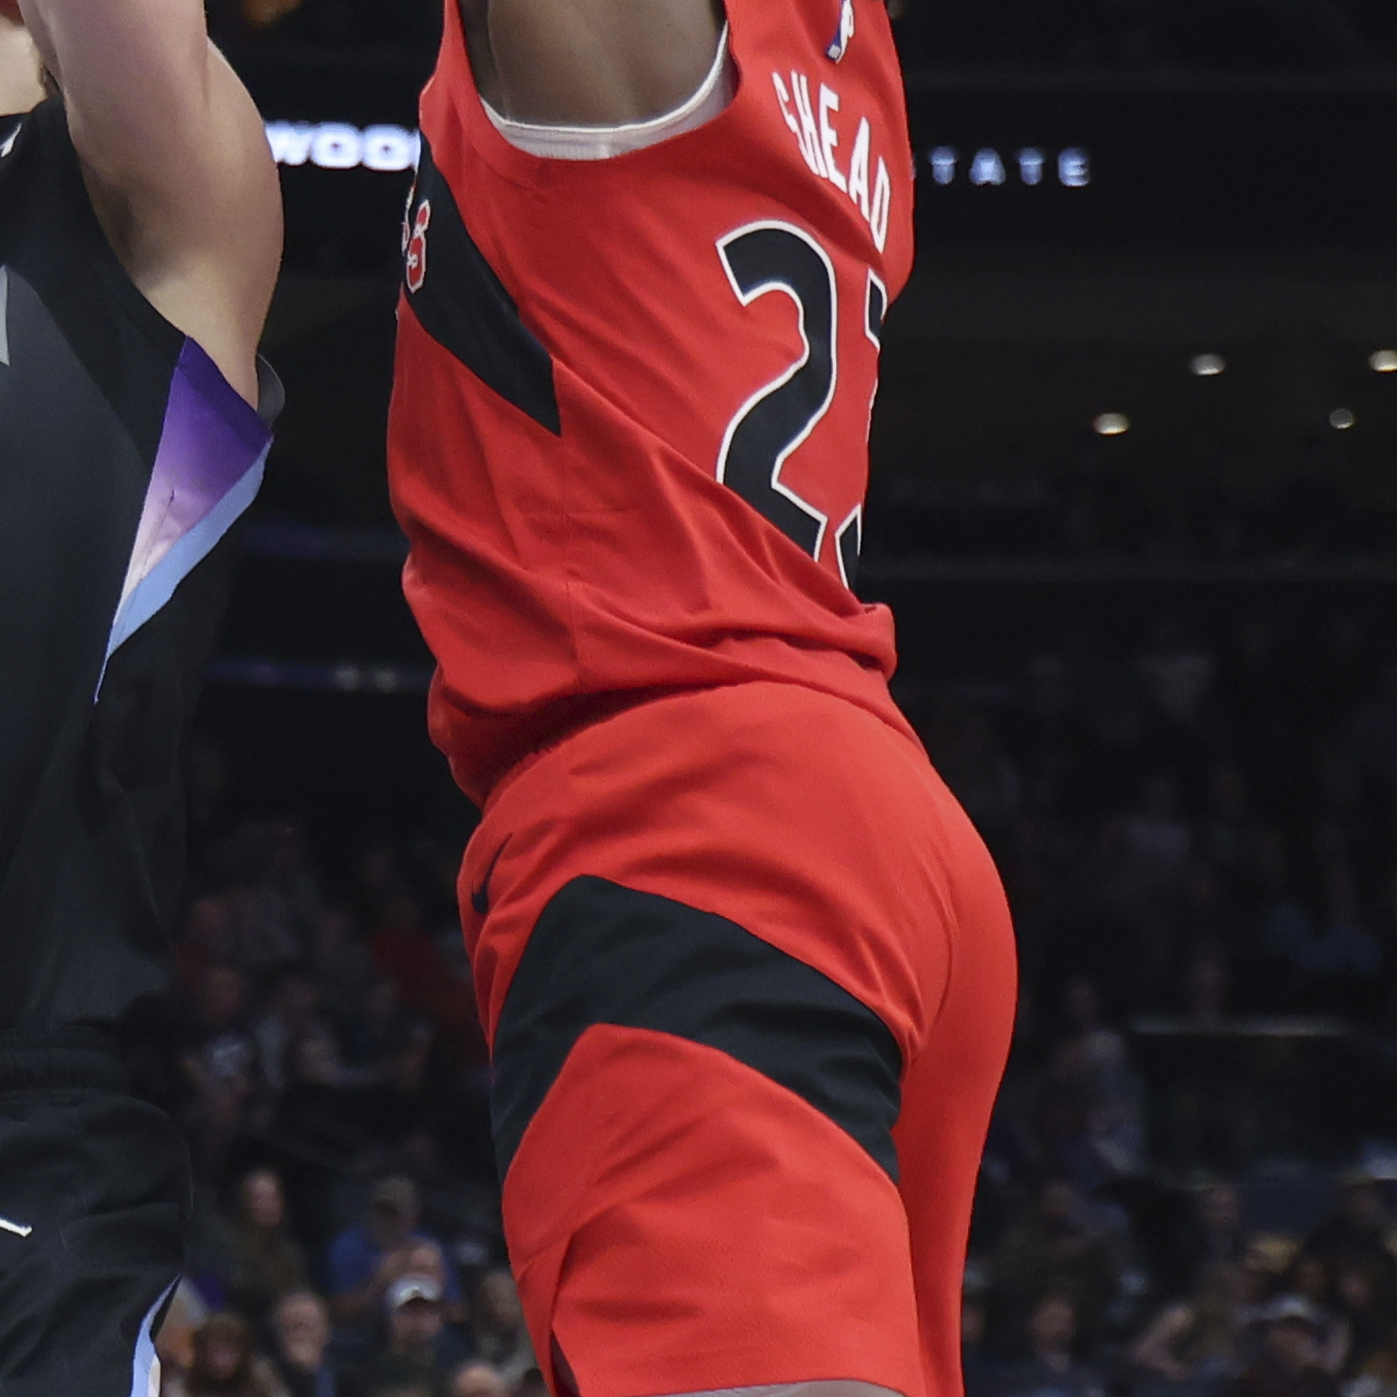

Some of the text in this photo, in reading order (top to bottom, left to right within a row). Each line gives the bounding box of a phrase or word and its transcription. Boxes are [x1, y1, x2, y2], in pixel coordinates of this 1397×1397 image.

[264, 120, 1091, 187] WOO TATE
[772, 68, 891, 254] SHEAD
